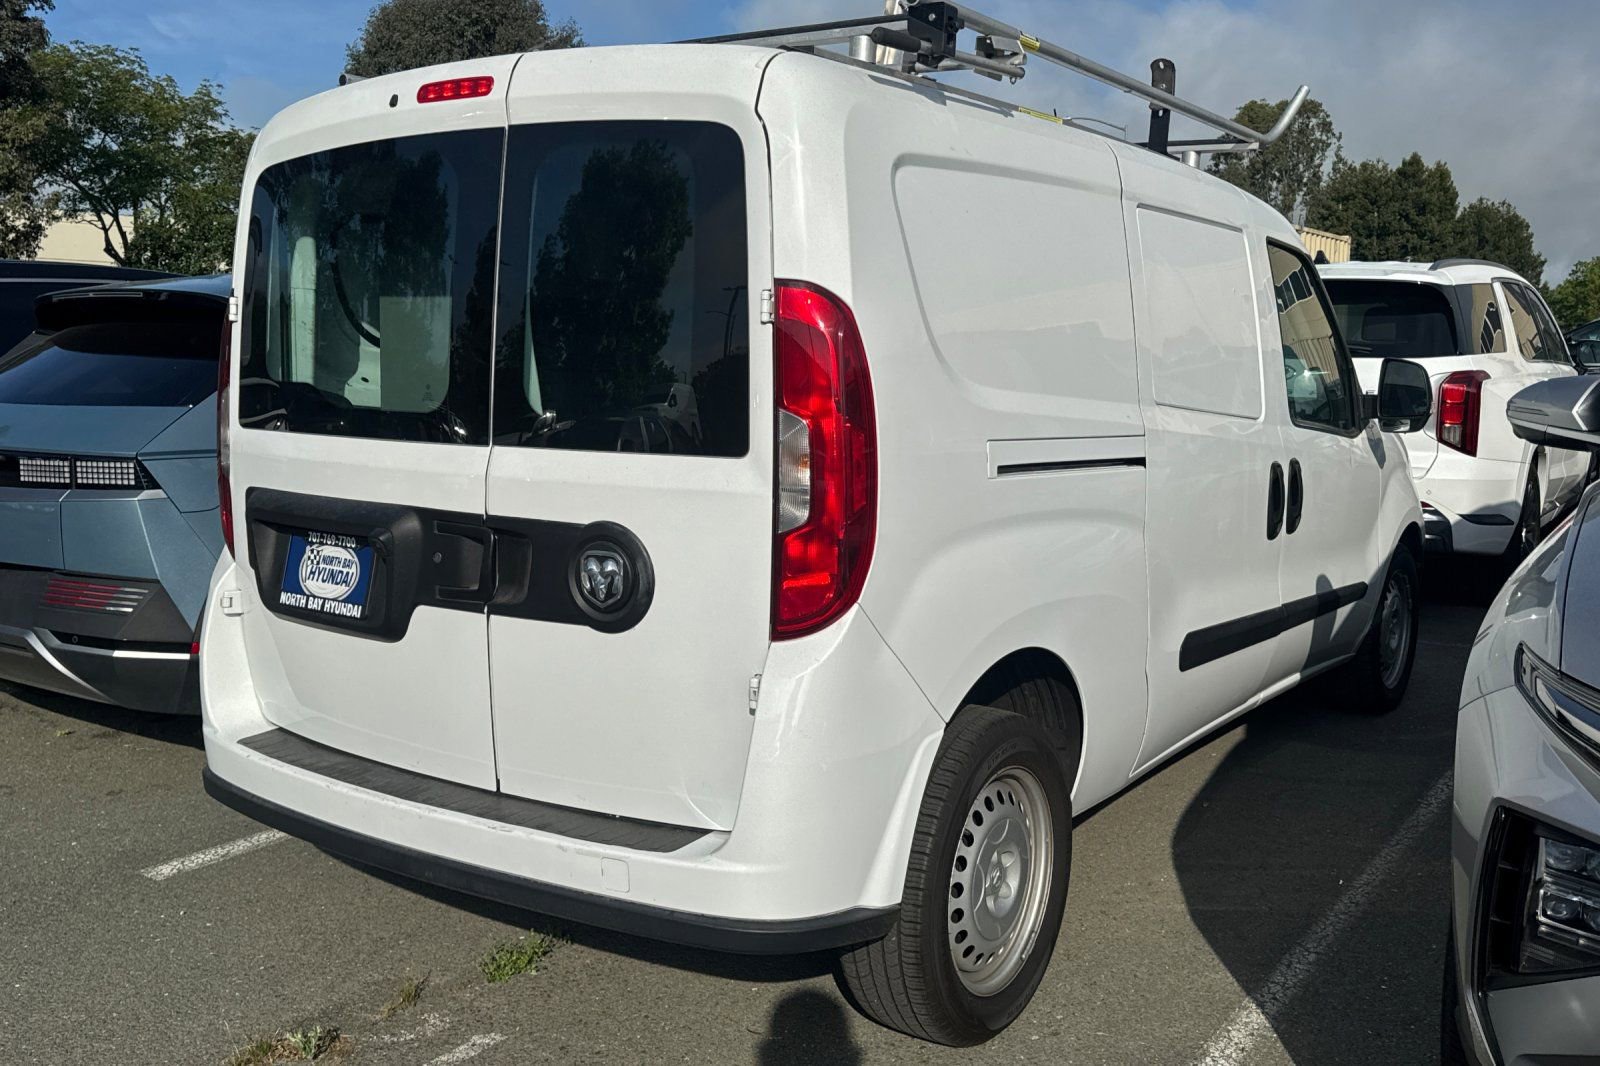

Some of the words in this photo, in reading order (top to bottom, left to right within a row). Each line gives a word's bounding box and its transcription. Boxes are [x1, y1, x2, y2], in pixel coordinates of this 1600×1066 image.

[308, 531, 356, 547] 707-769-7700
[321, 554, 341, 567] NORTH
[342, 557, 354, 570] BAY
[308, 565, 354, 587] HYUNDAI
[280, 591, 306, 608] NORTH
[307, 597, 323, 611] BAY
[324, 601, 362, 618] HYUNDAI
